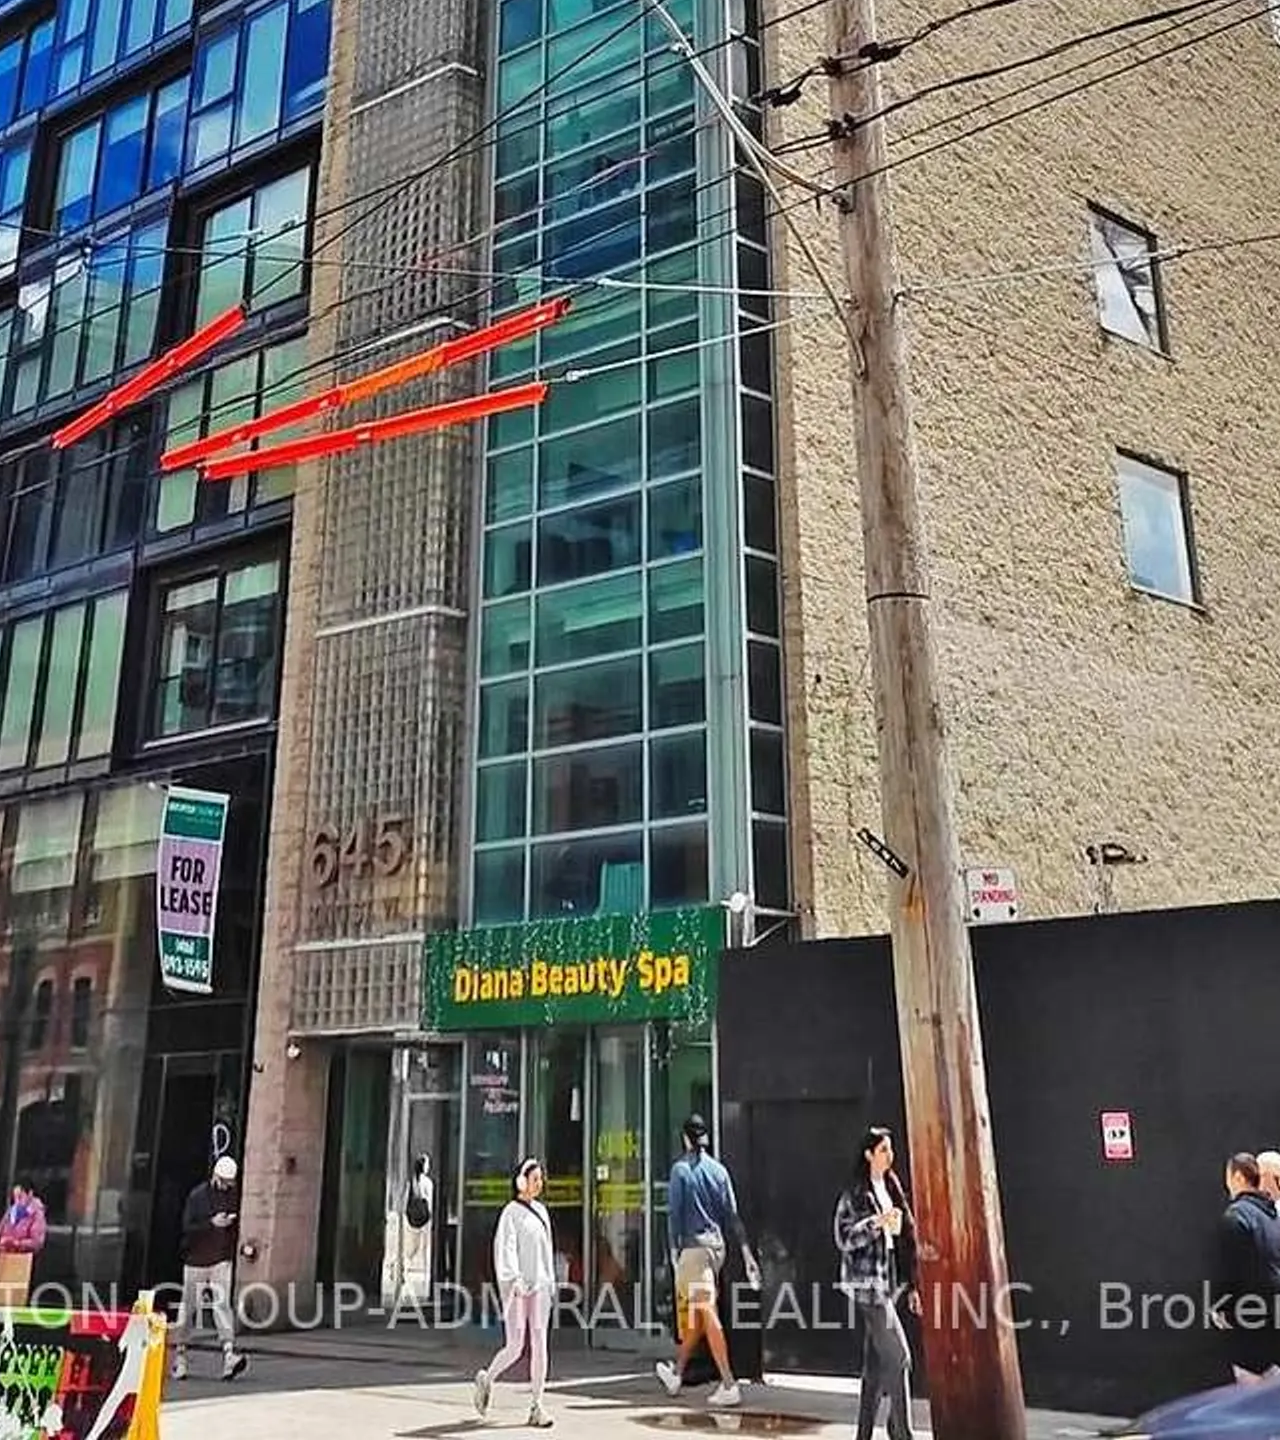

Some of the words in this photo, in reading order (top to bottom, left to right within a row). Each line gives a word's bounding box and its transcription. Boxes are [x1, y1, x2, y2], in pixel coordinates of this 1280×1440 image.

[171, 856, 206, 884] FOR
[308, 814, 408, 886] 645
[160, 886, 213, 916] LEASE
[453, 963, 523, 1003] Diana
[531, 956, 628, 997] Beauty
[637, 948, 690, 994] Spa
